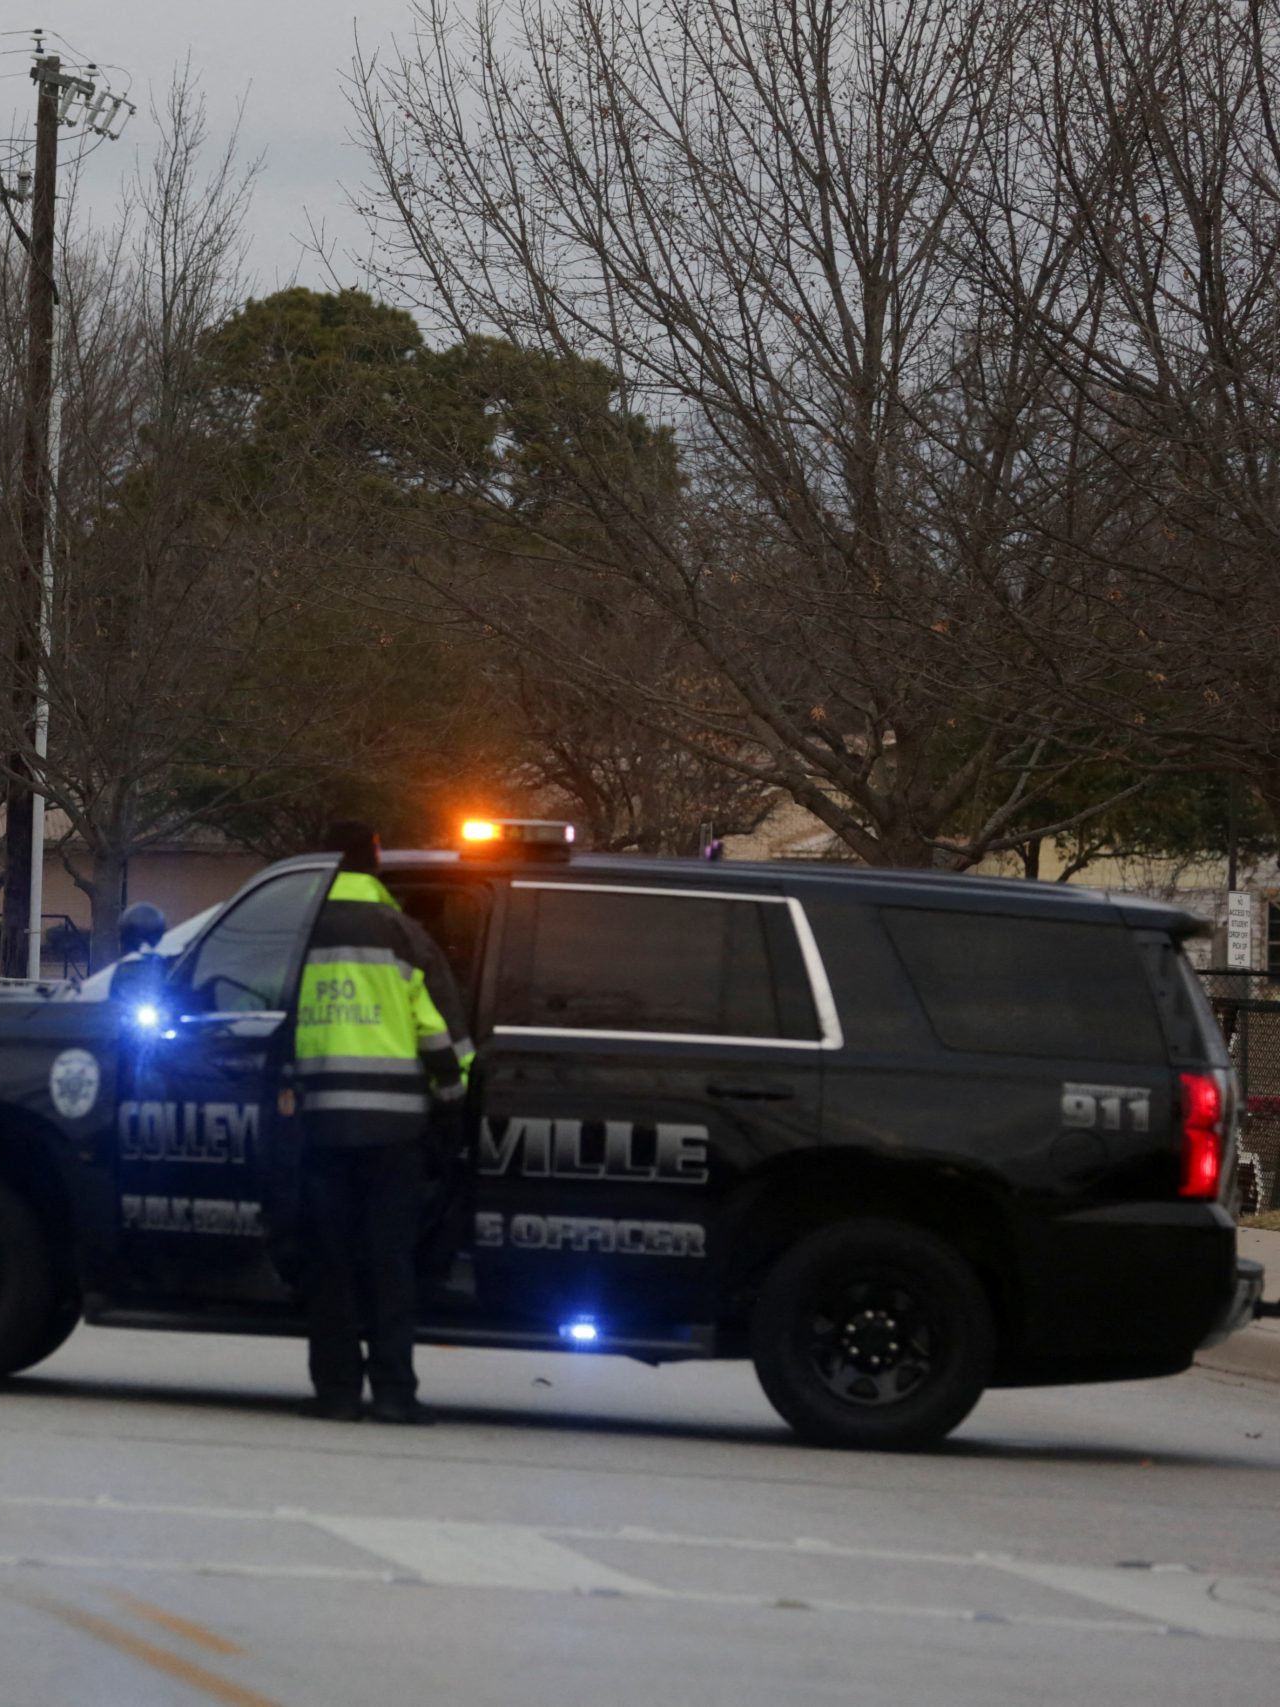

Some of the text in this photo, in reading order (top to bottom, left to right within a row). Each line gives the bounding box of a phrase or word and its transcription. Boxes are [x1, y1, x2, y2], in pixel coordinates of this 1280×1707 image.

[1229, 909, 1245, 917] ACCESS
[1231, 920, 1249, 928] STUDENT
[1234, 953, 1246, 961] LANE
[315, 978, 357, 1000] PSO
[1062, 1094, 1150, 1132] 911
[120, 1101, 709, 1184] COLLEY VILLE
[510, 1213, 707, 1258] OFFICER
